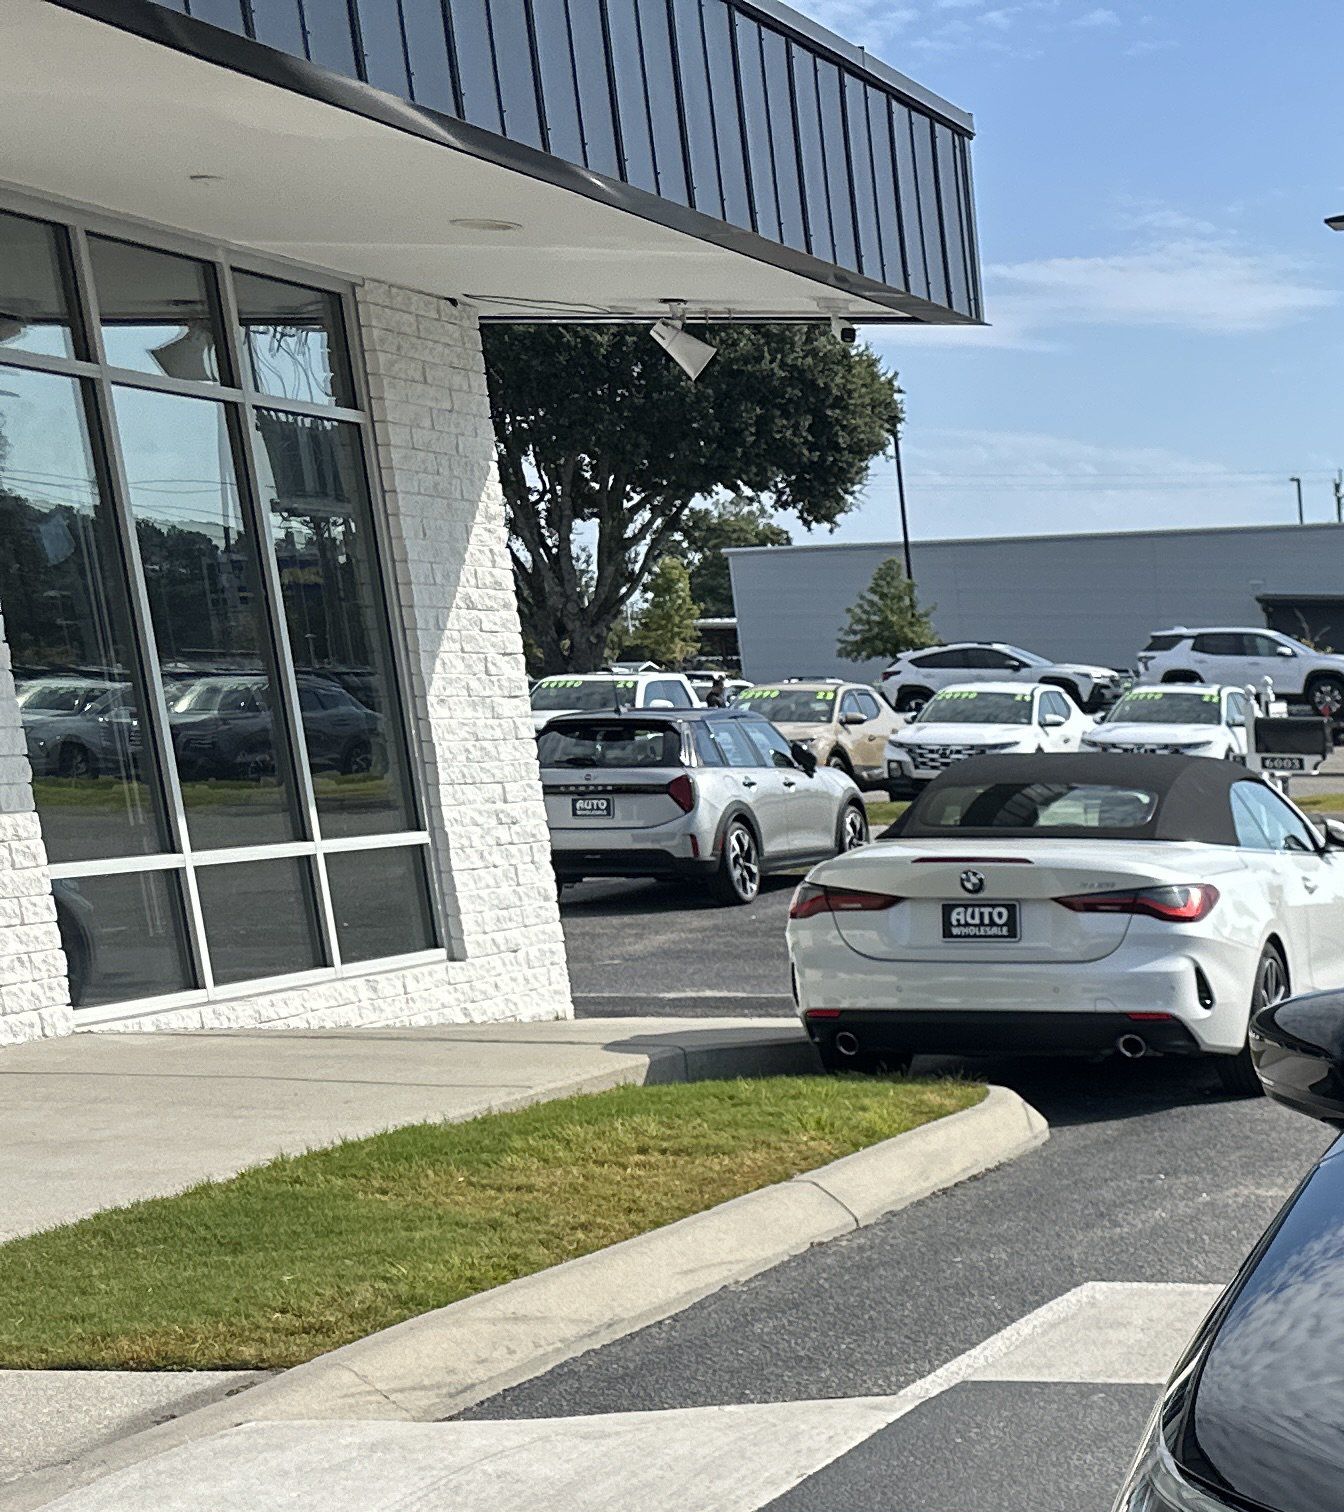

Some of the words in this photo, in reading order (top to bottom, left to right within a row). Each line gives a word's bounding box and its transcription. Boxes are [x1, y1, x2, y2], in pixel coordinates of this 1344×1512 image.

[1265, 758, 1302, 770] 6003
[575, 799, 608, 810] AUTO
[951, 906, 1009, 926] AUTO
[951, 926, 1009, 936] WHOLESALE
